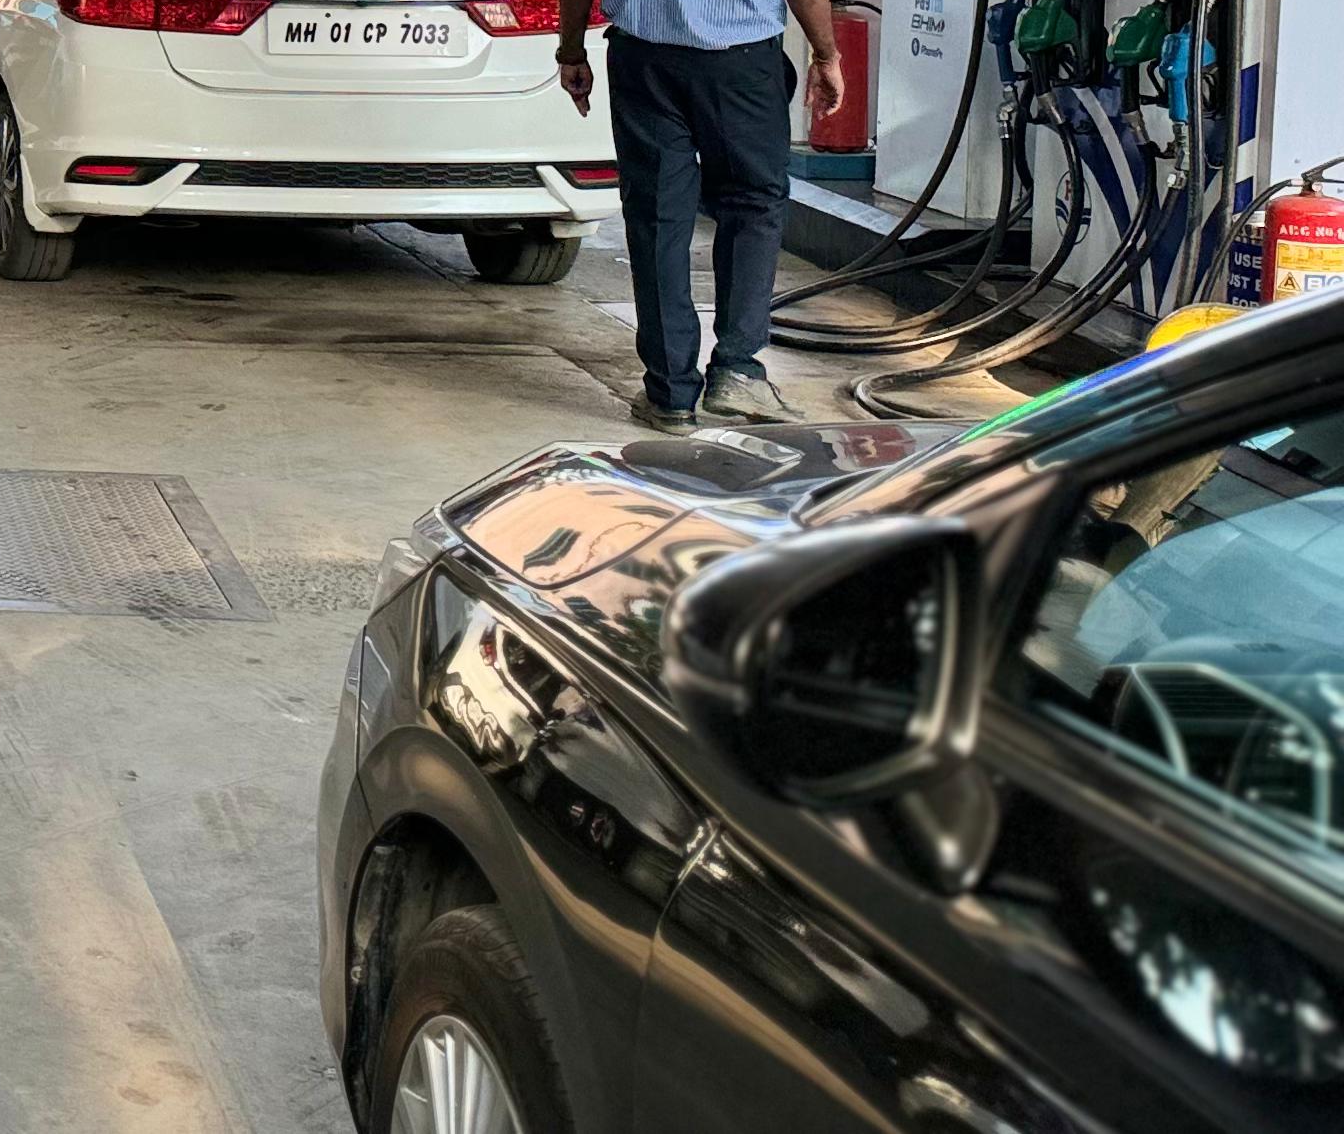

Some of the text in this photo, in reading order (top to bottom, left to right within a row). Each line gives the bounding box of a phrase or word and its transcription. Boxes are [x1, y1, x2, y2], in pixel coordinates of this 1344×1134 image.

[284, 22, 450, 45] MH 01 CP 7033
[911, 13, 943, 34] BHIM
[1234, 252, 1263, 270] USE
